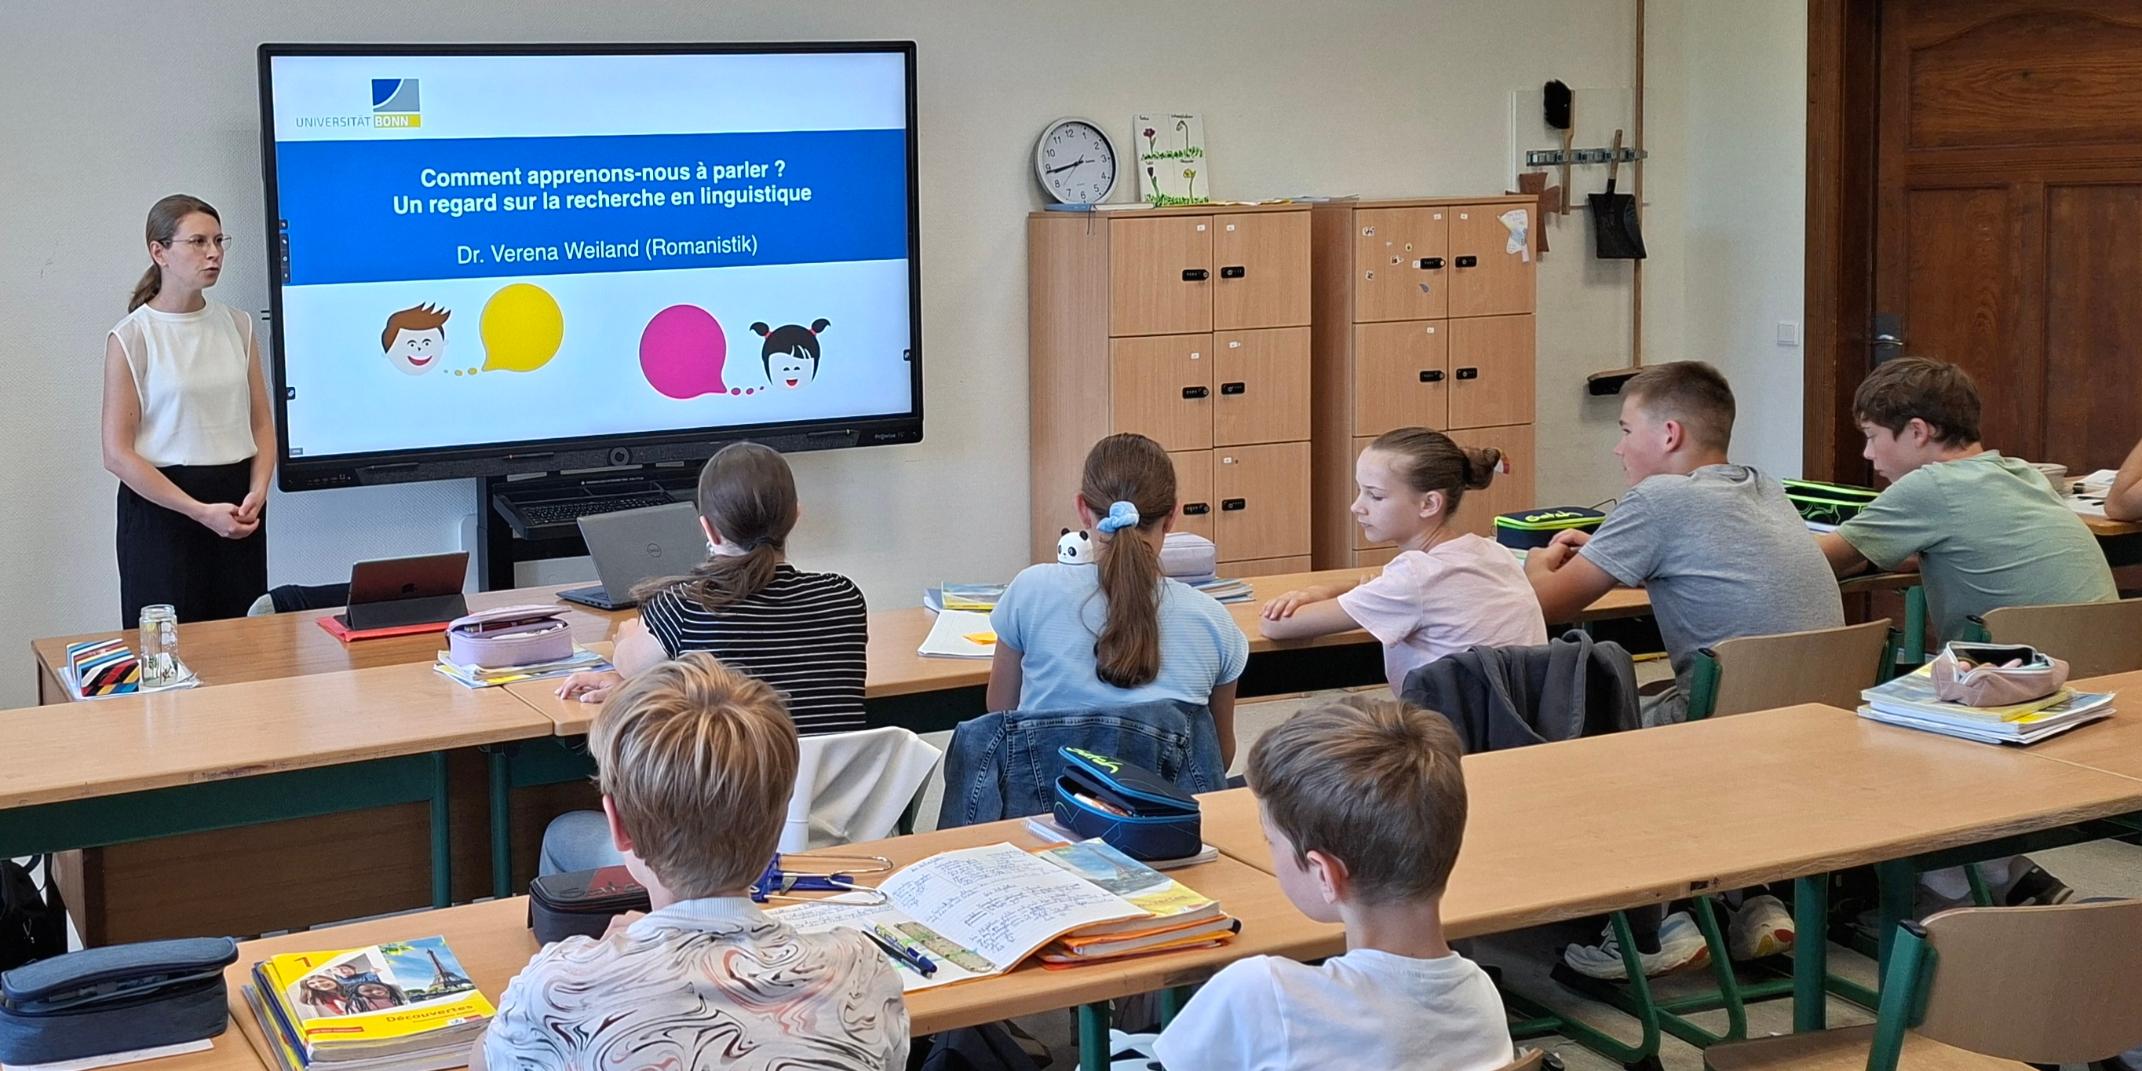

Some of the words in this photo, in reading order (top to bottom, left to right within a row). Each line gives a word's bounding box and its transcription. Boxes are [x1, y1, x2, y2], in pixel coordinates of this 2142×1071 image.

[296, 115, 371, 128] UNIVERSITÄT
[374, 115, 409, 127] BONN
[1065, 128, 1074, 138] 12
[1053, 136, 1062, 144] 11
[1093, 142, 1100, 150] 2
[1046, 148, 1056, 158] 10
[1100, 154, 1107, 163] 3
[1045, 163, 1052, 172] 9
[421, 167, 522, 188] Comment
[527, 165, 691, 189] apprenons-nous
[696, 161, 708, 180] à
[713, 160, 769, 184] parler
[774, 159, 786, 178] ?
[1101, 171, 1107, 180] 4
[1054, 179, 1061, 188] 8
[1066, 188, 1072, 197] 7
[1093, 184, 1100, 193] 5
[1080, 191, 1087, 200] 6
[393, 195, 423, 215] Un
[429, 193, 497, 218] regard
[503, 195, 537, 211] sur
[542, 191, 561, 210] la
[566, 188, 666, 209] recherche
[671, 191, 695, 205] en
[700, 184, 812, 209] linguistique
[457, 245, 485, 265] Dr.
[491, 243, 559, 263] Verena
[564, 239, 639, 261] Weiland
[646, 234, 758, 261] (Romanistik)
[386, 1005, 473, 1022] Découvertes
